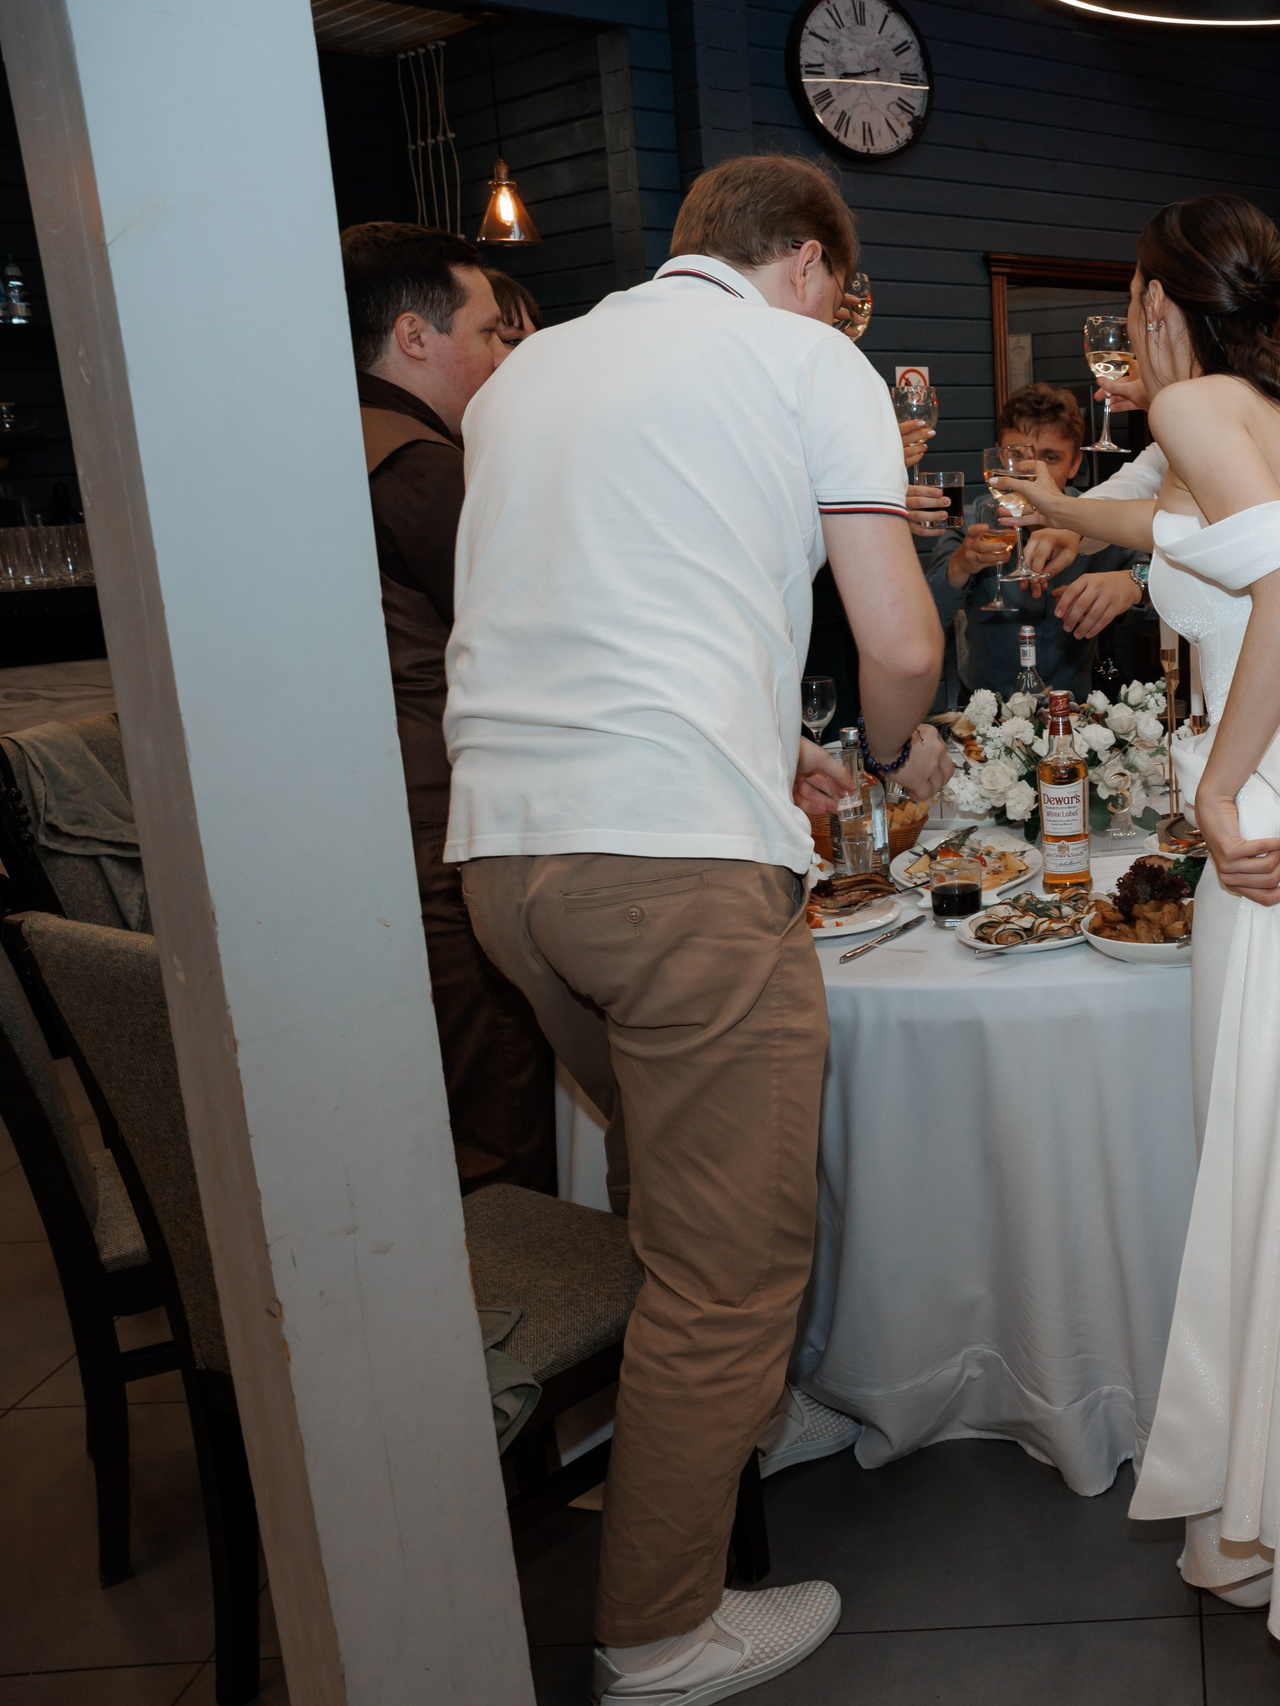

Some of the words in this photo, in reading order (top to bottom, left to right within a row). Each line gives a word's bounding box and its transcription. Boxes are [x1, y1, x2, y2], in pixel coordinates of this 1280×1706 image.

[878, 14, 889, 35] I
[892, 40, 912, 57] II
[899, 72, 920, 87] III
[833, 109, 852, 138] VII
[863, 121, 878, 147] VI
[1043, 792, 1081, 806] Dewar's
[1107, 772, 1132, 814] 3
